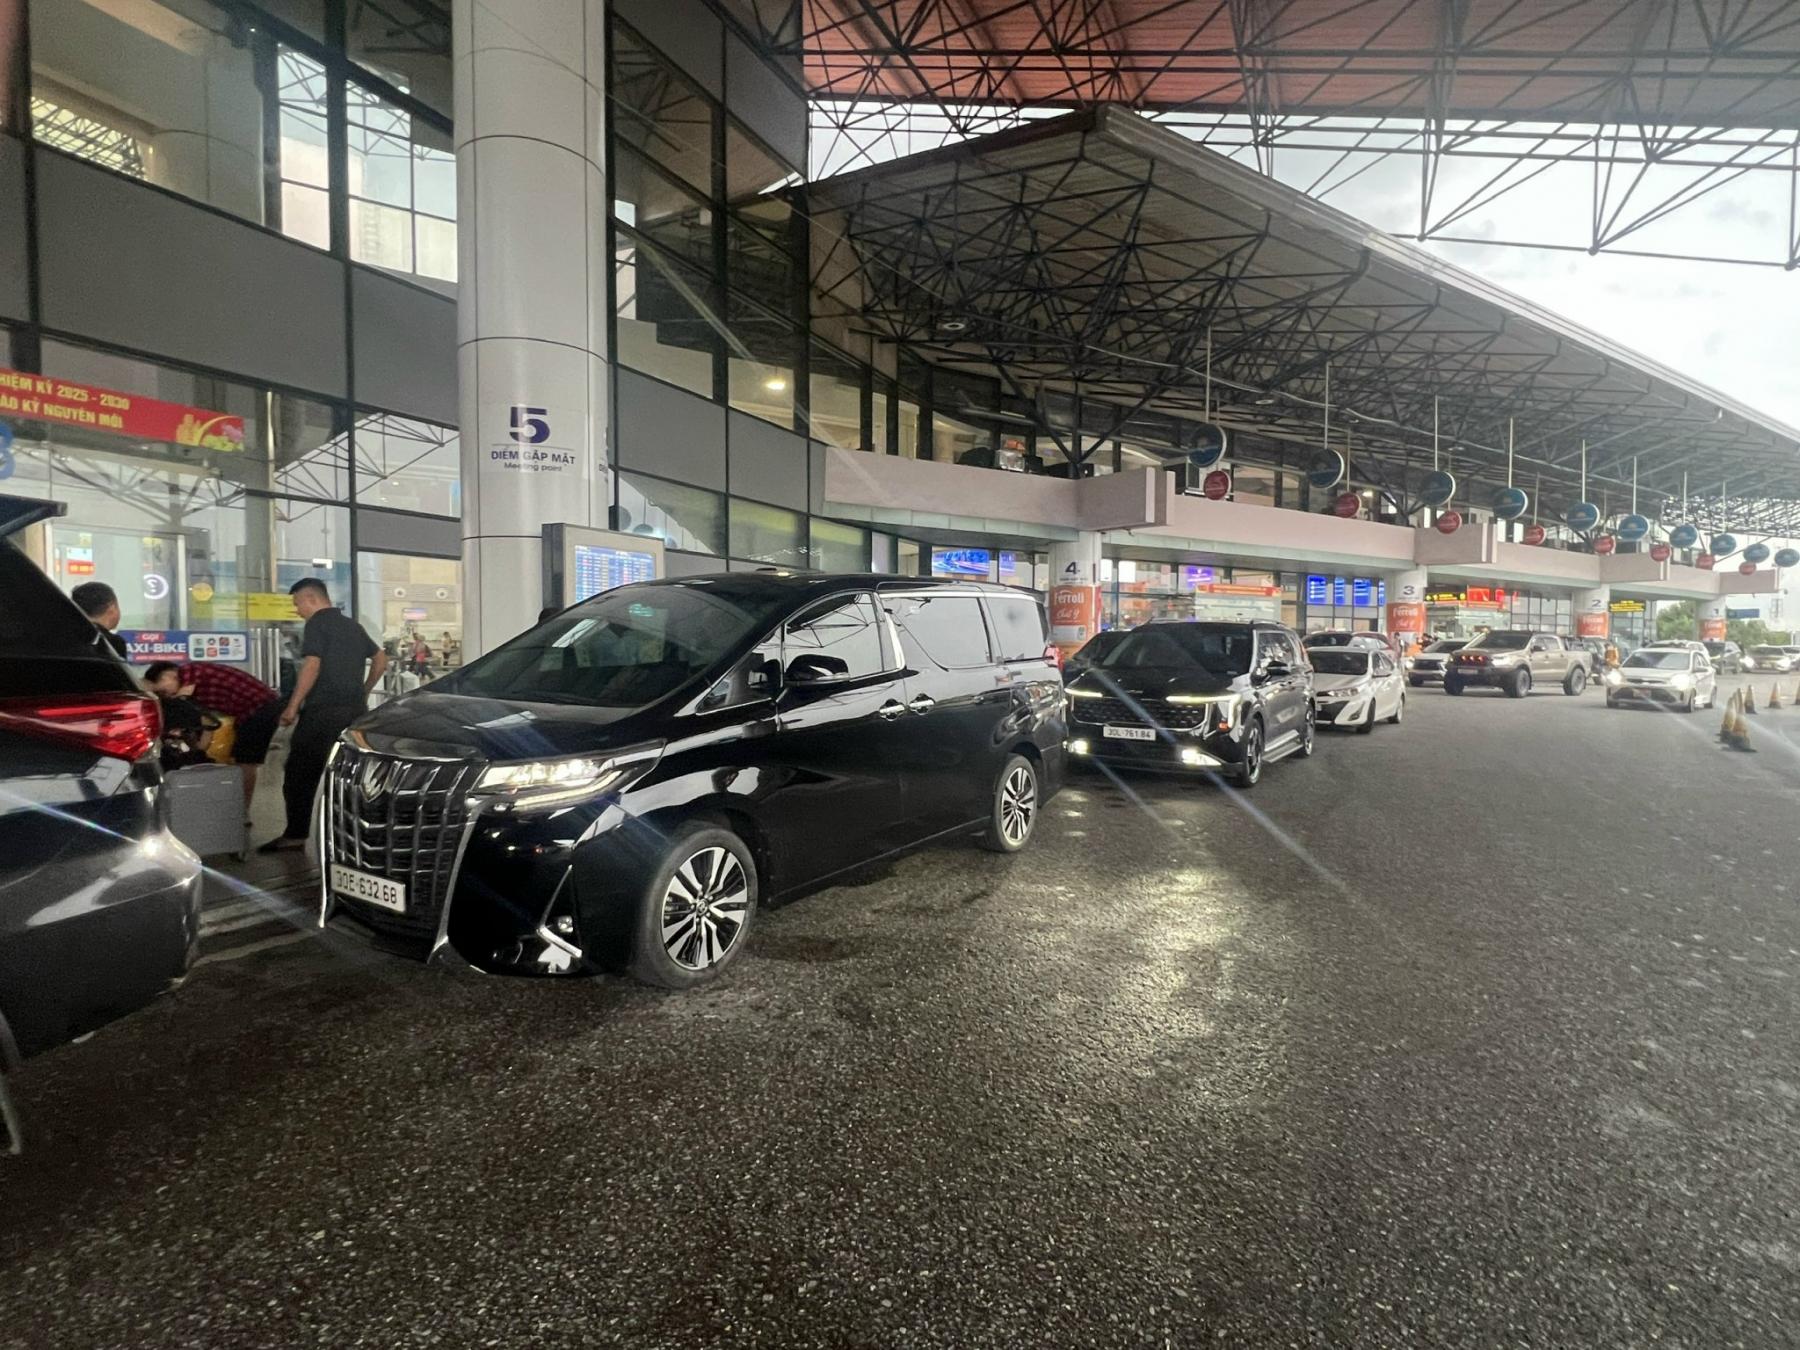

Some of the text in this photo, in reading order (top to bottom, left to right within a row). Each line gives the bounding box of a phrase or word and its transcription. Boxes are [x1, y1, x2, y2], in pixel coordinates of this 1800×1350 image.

[57, 385, 88, 402] 2025
[100, 393, 131, 410] 2030
[509, 406, 550, 443] 5
[1065, 562, 1077, 575] 4
[1403, 585, 1415, 595] 3
[126, 643, 186, 653] AXI-BIKE
